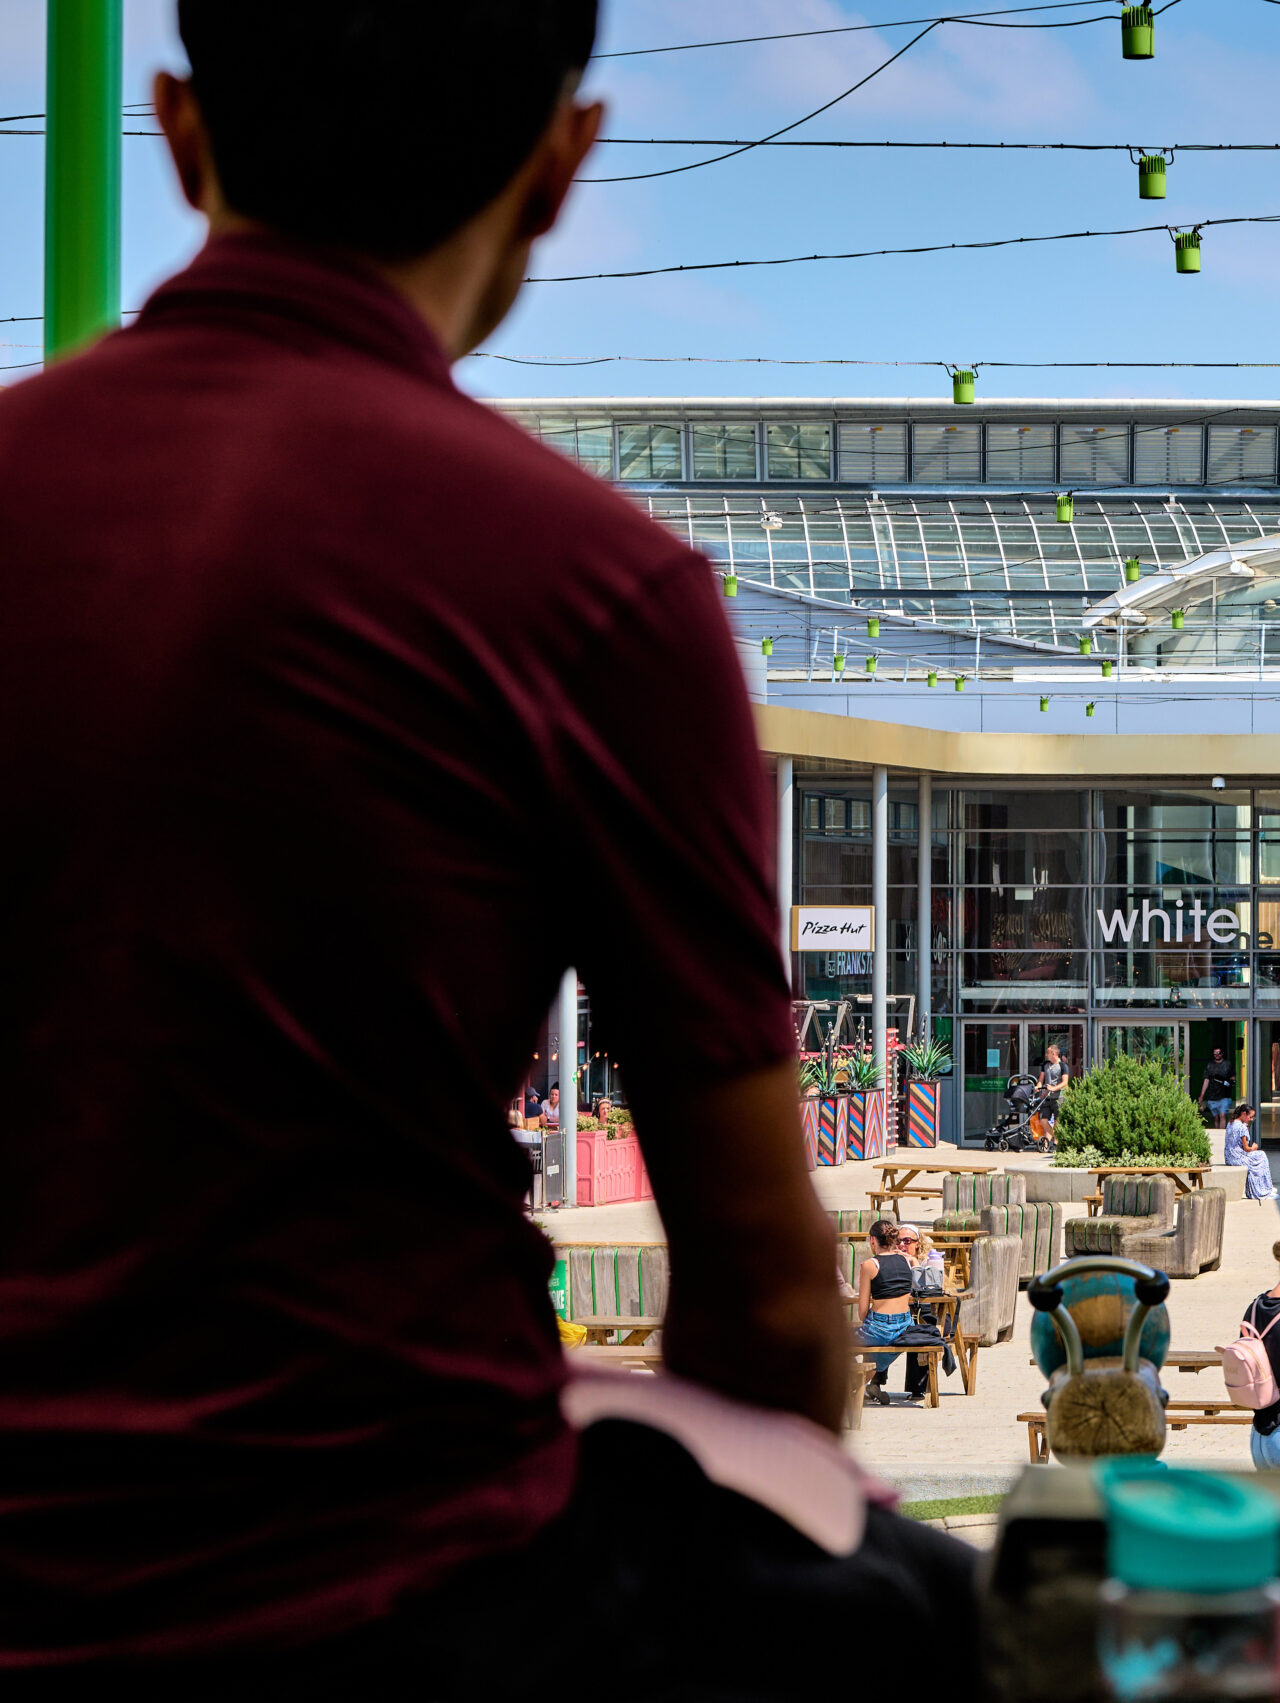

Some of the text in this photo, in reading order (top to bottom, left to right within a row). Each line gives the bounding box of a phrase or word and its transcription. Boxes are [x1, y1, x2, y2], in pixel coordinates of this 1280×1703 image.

[801, 921, 868, 936] Pizza Hut
[1096, 899, 1240, 943] white
